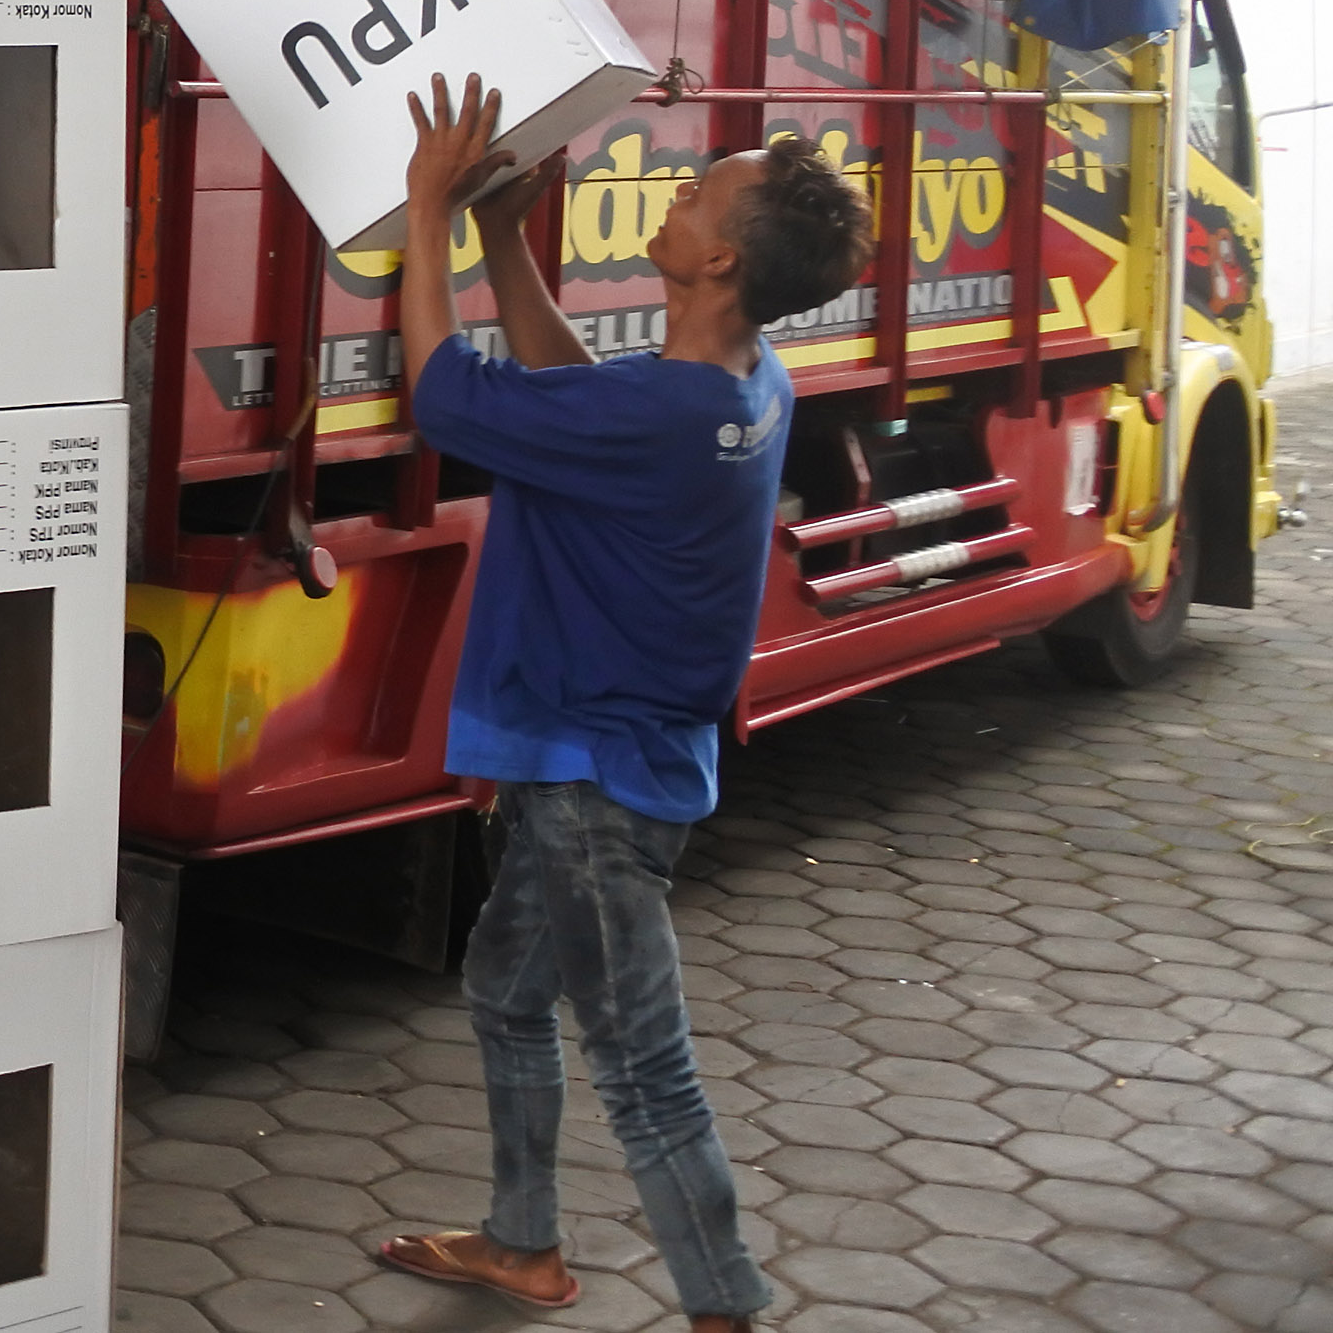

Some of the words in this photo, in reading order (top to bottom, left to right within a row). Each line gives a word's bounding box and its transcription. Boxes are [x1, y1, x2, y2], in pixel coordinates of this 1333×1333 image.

[15, 4, 50, 19] Kotak
[53, 5, 92, 19] Nomor
[49, 437, 99, 453] Provinsi
[34, 483, 61, 498] PPK
[65, 480, 98, 494] Nama
[36, 504, 60, 520] PPS
[65, 501, 97, 514] Nama
[30, 526, 53, 542] TPS
[57, 522, 97, 536] Nomor
[18, 547, 53, 564] Kotak
[57, 544, 97, 557] Nomor
